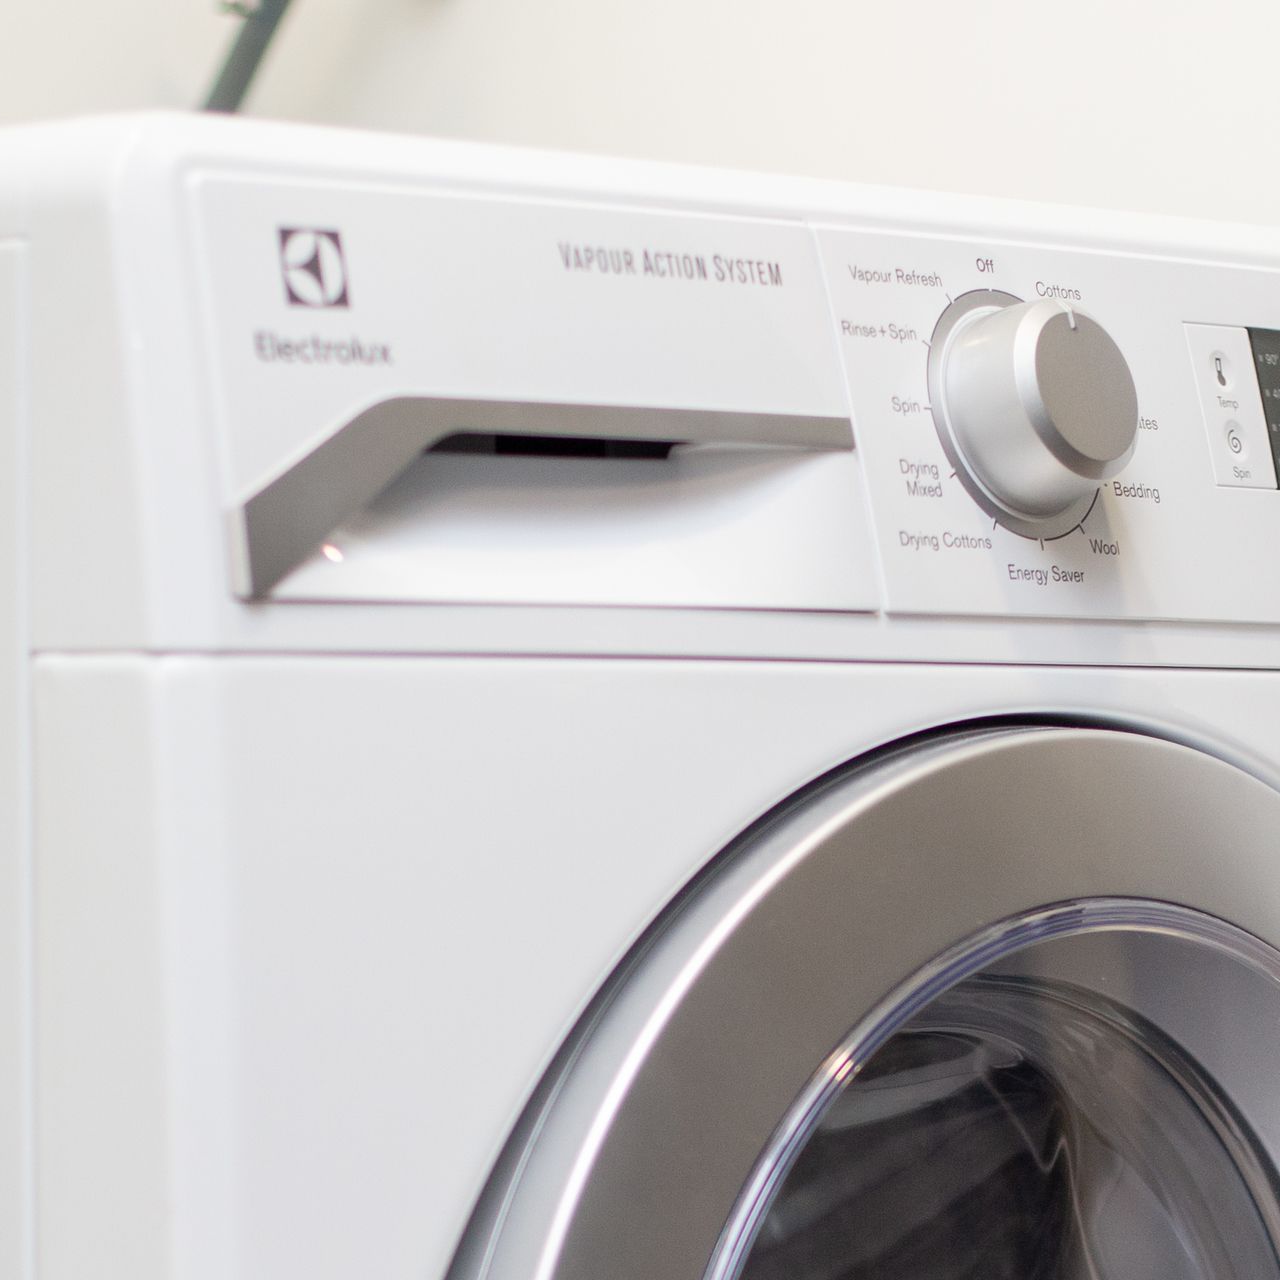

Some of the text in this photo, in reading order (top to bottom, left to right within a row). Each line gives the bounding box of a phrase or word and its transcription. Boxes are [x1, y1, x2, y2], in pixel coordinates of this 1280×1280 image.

[558, 241, 784, 287] VAPOUR ACTION SYSTEM
[976, 258, 994, 273] Off
[848, 264, 943, 287] Vapour Refresh
[1035, 281, 1082, 300] Cottons
[254, 328, 393, 366] Electrolux
[891, 396, 920, 416] Spin
[1216, 395, 1240, 412] Temp
[899, 458, 939, 480] Drying
[1233, 465, 1252, 480] Spin
[906, 480, 943, 498] Mixed
[1113, 481, 1161, 503] Bedding
[899, 530, 993, 551] Drying Cottons
[1089, 538, 1120, 556] Wool
[1008, 563, 1085, 586] Energy Saver
